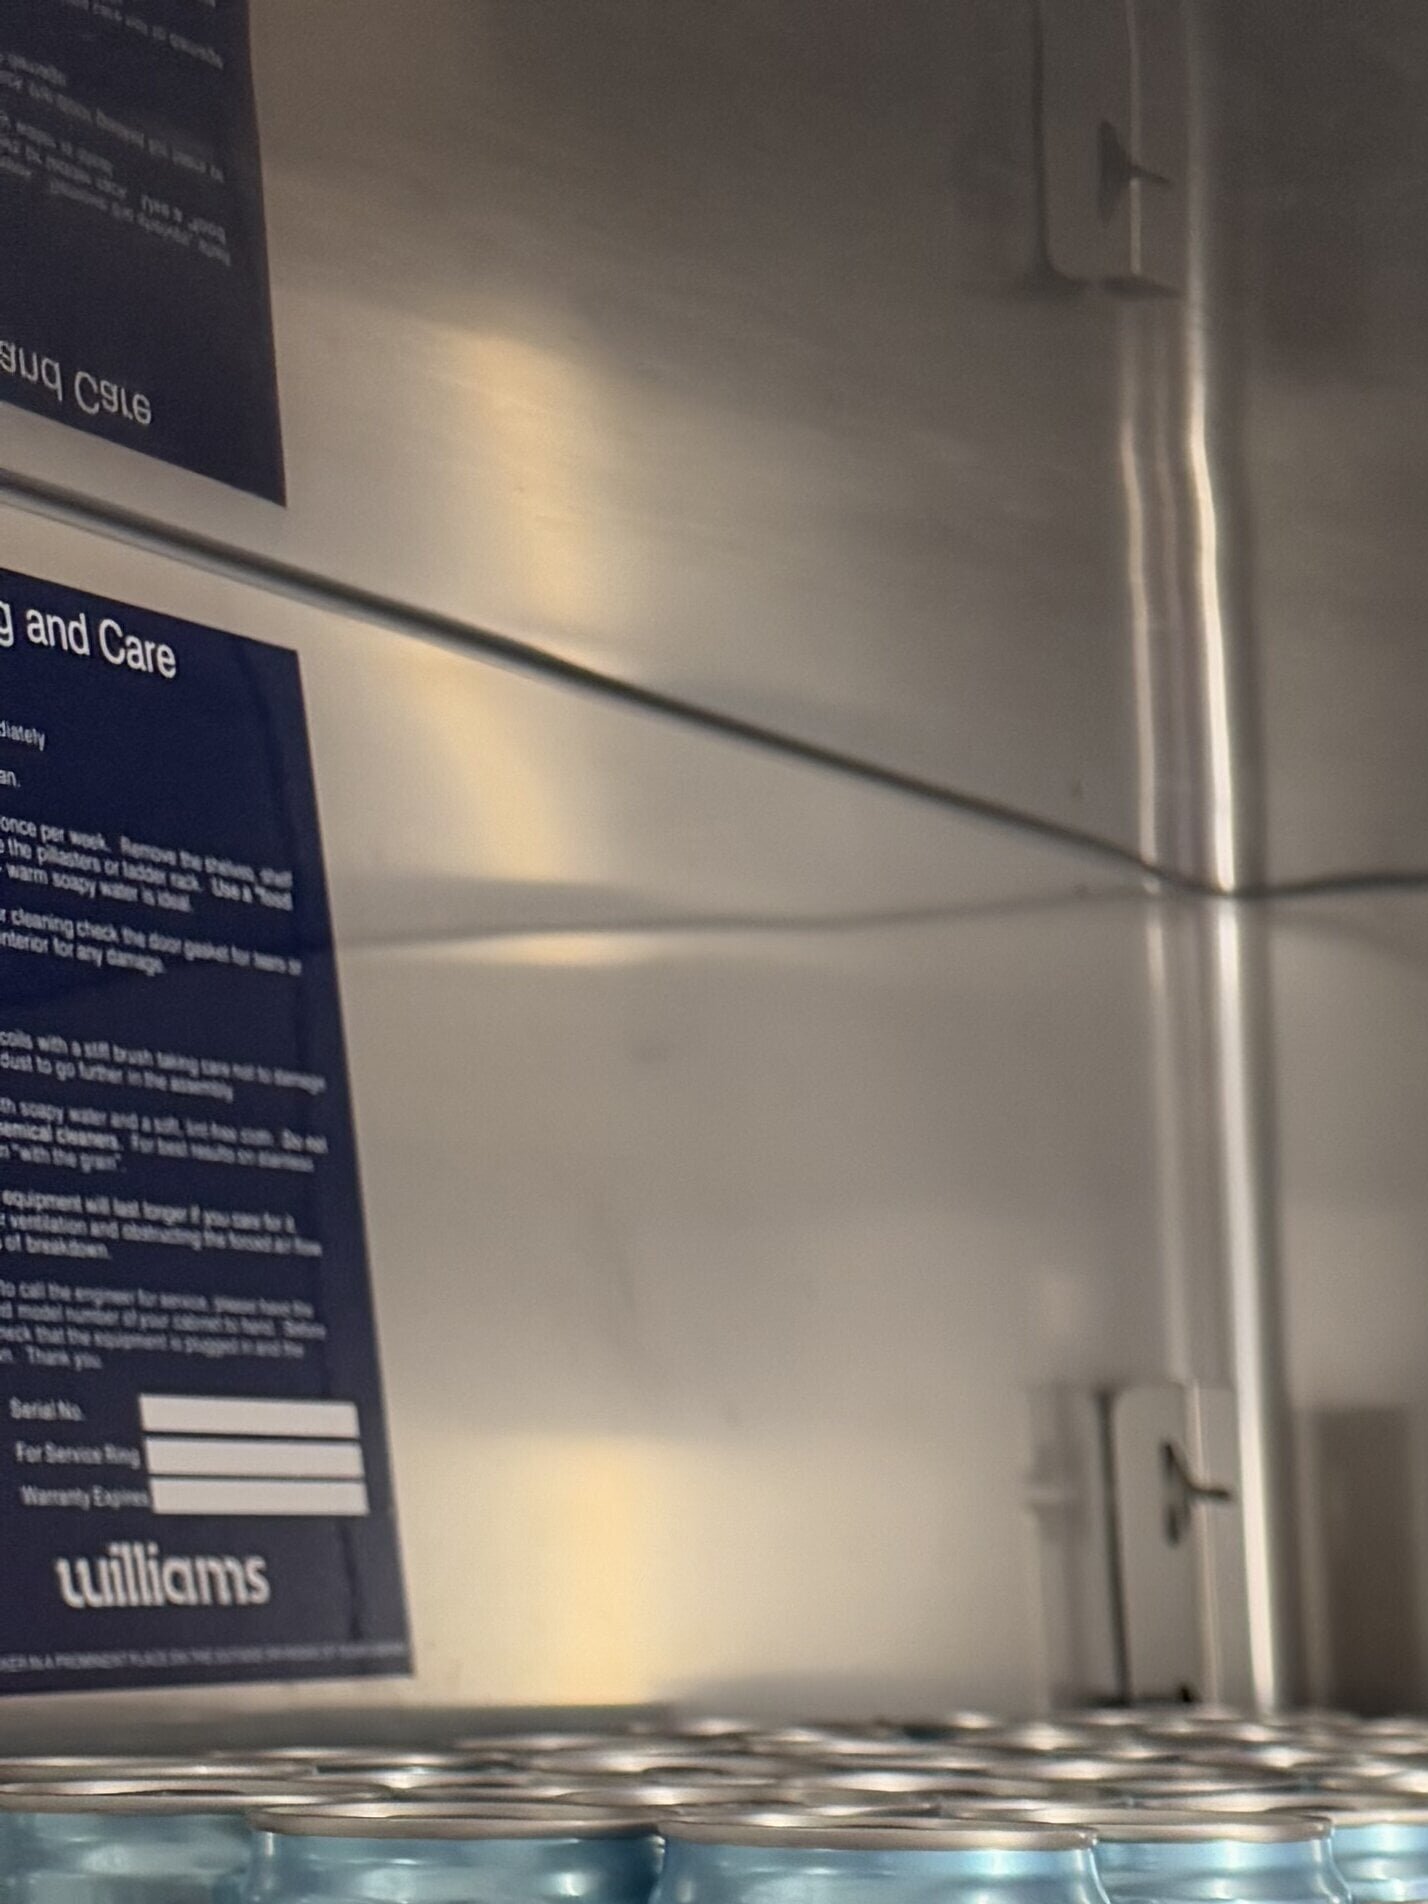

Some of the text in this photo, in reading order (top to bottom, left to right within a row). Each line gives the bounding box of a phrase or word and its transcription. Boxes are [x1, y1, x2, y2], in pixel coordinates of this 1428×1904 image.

[26, 606, 91, 655] and
[99, 617, 177, 679] Care
[6, 861, 50, 885] warm
[53, 1541, 272, 1609] williams
